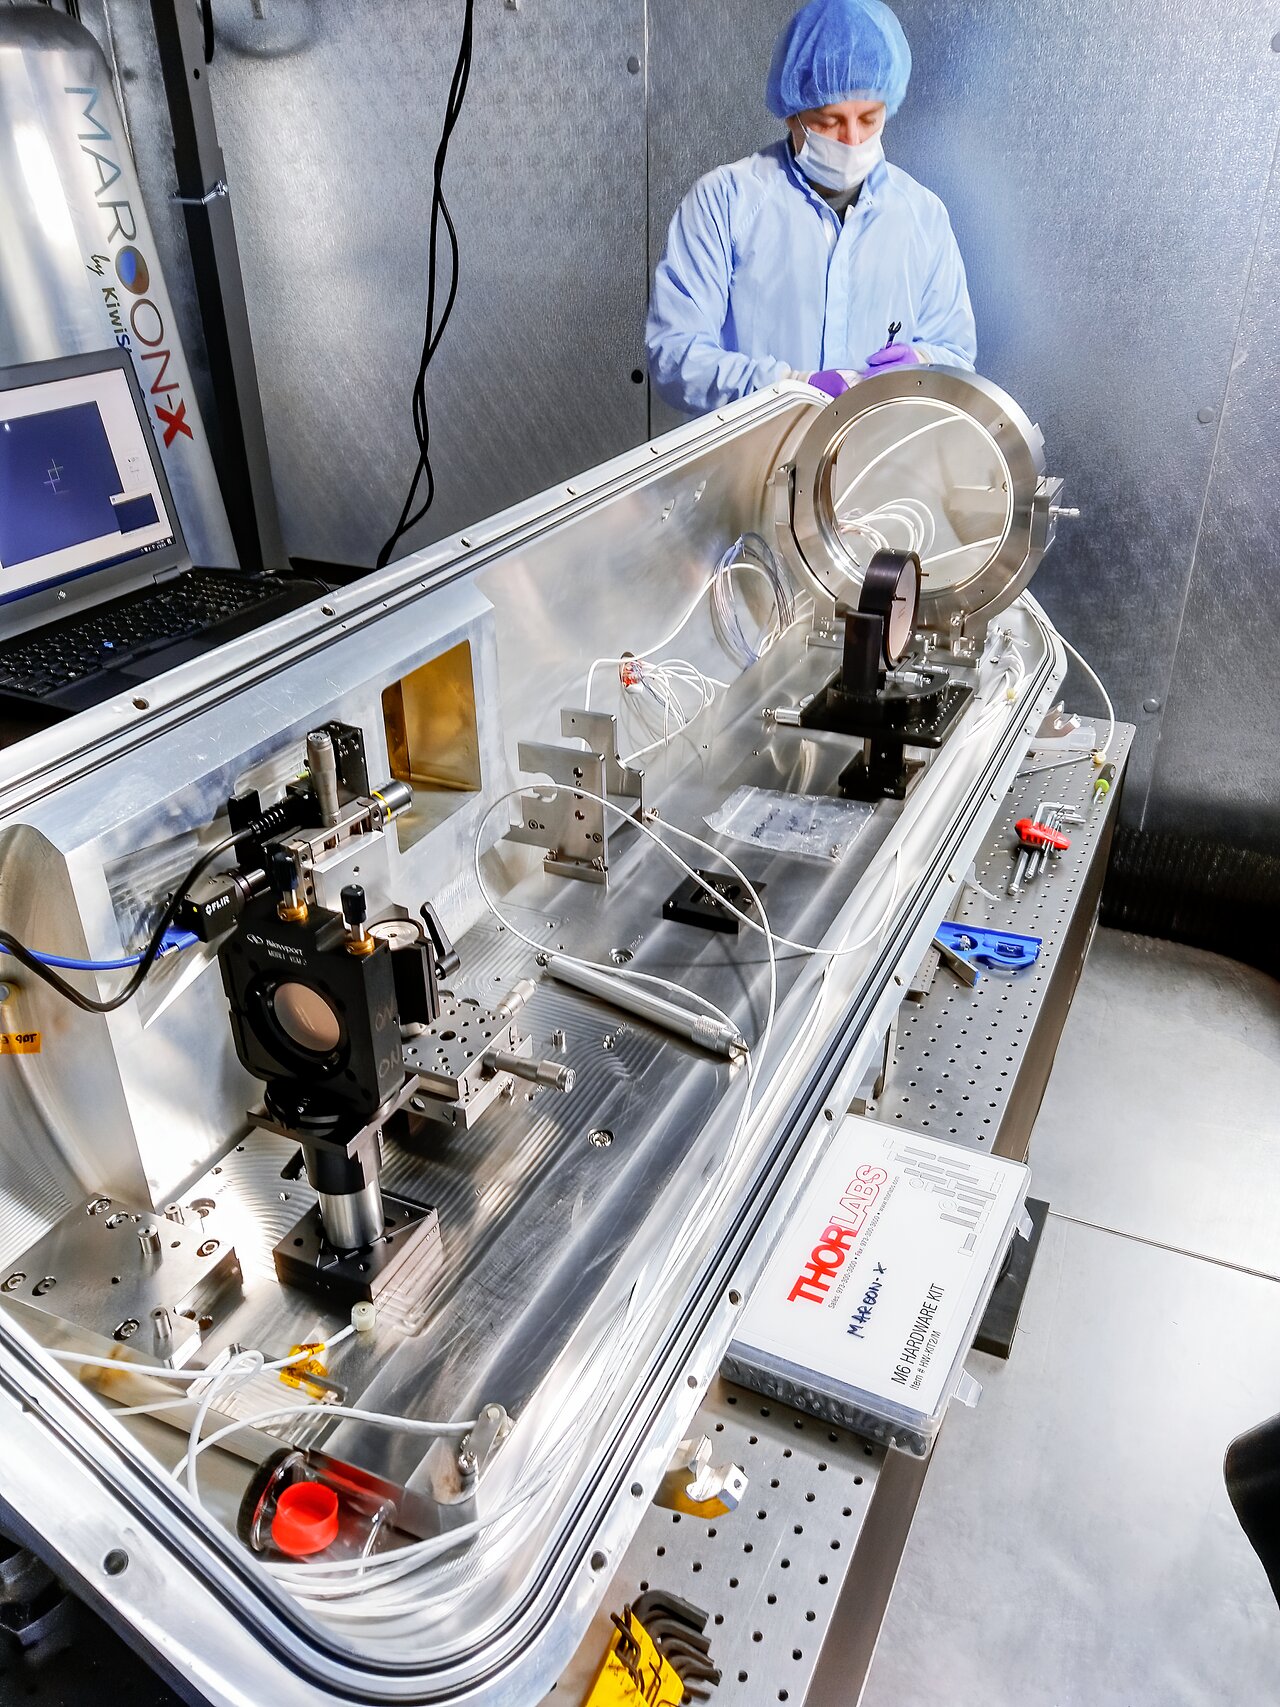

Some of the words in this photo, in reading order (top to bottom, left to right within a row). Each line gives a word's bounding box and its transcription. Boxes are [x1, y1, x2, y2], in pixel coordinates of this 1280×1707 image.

[86, 254, 111, 277] by
[211, 895, 230, 912] FLIR
[787, 1164, 887, 1304] THORLABS
[926, 1282, 945, 1302] KIT
[900, 1301, 938, 1365] HARDWARE
[891, 1364, 911, 1385] M6
[909, 1374, 924, 1391] Item
